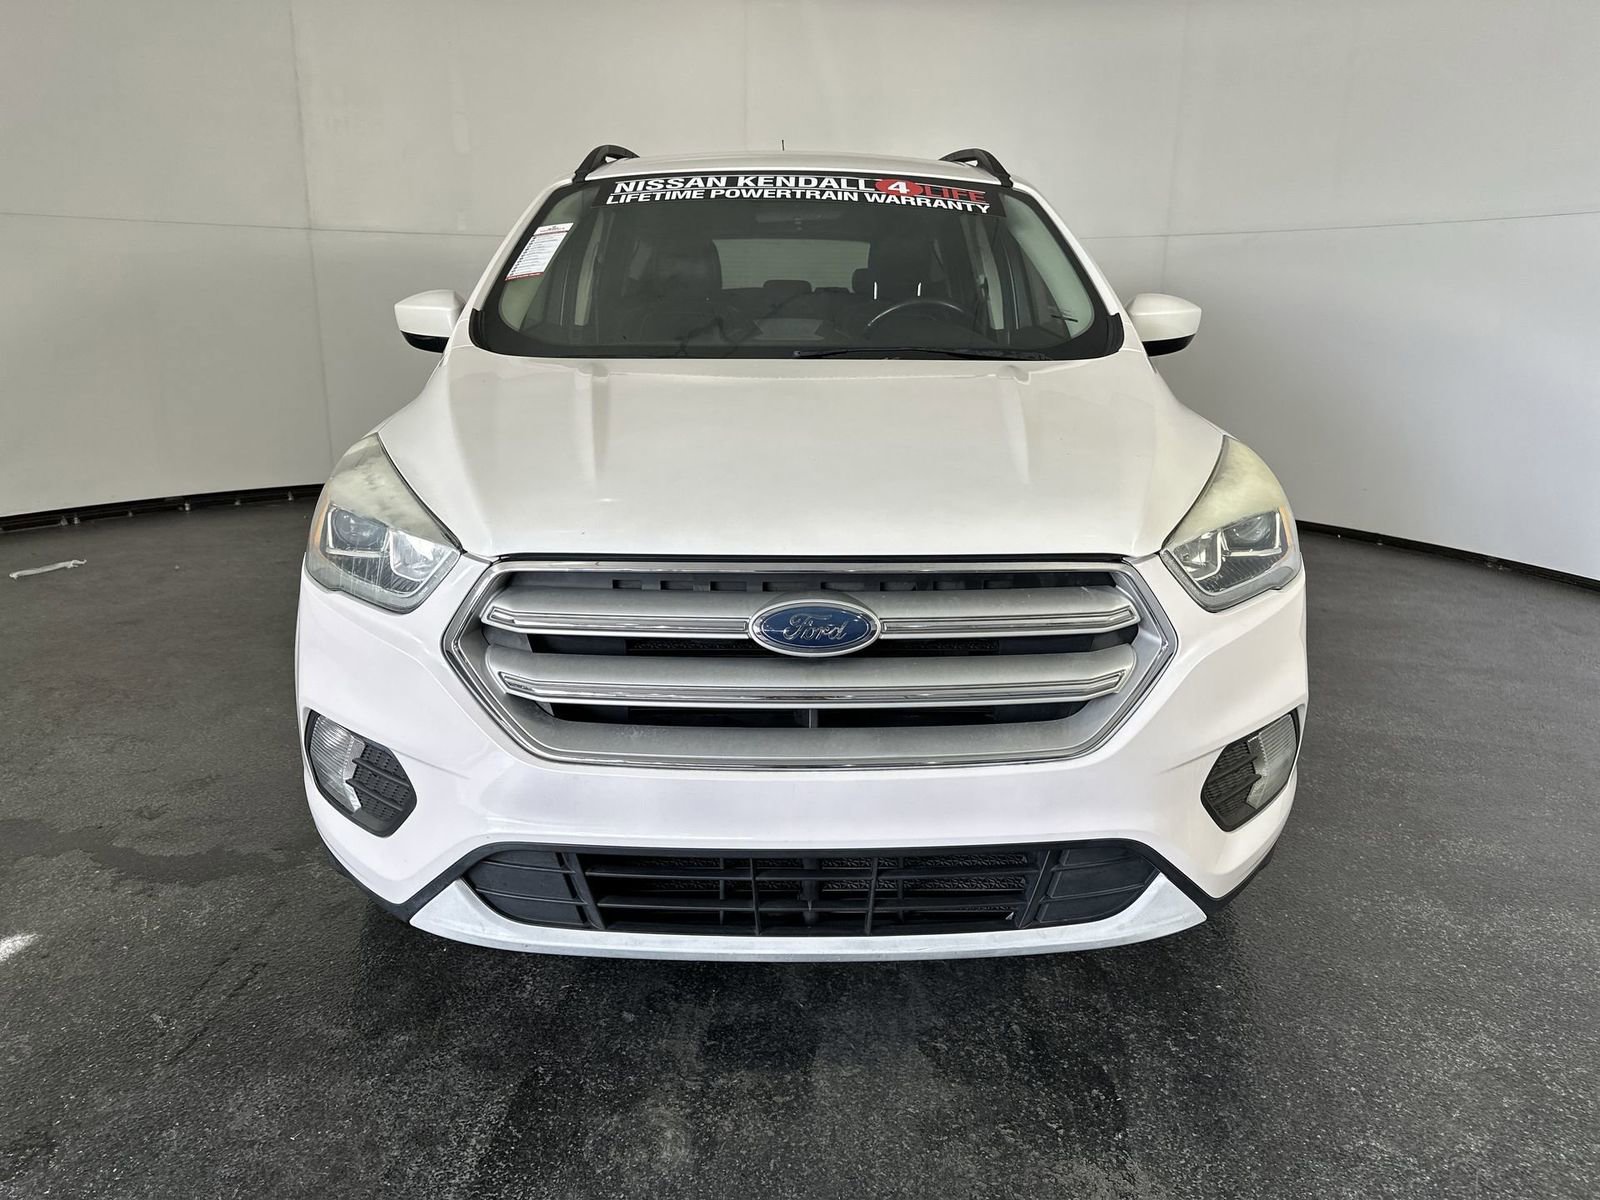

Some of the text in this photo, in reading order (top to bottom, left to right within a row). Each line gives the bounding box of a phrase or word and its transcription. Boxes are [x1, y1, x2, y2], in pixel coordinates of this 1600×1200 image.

[606, 188, 990, 214] LIFETIME POWERTRAIN WARRANTY
[614, 175, 986, 202] NISSAN KENDALL 4 LIFE
[783, 613, 848, 640] Ford
